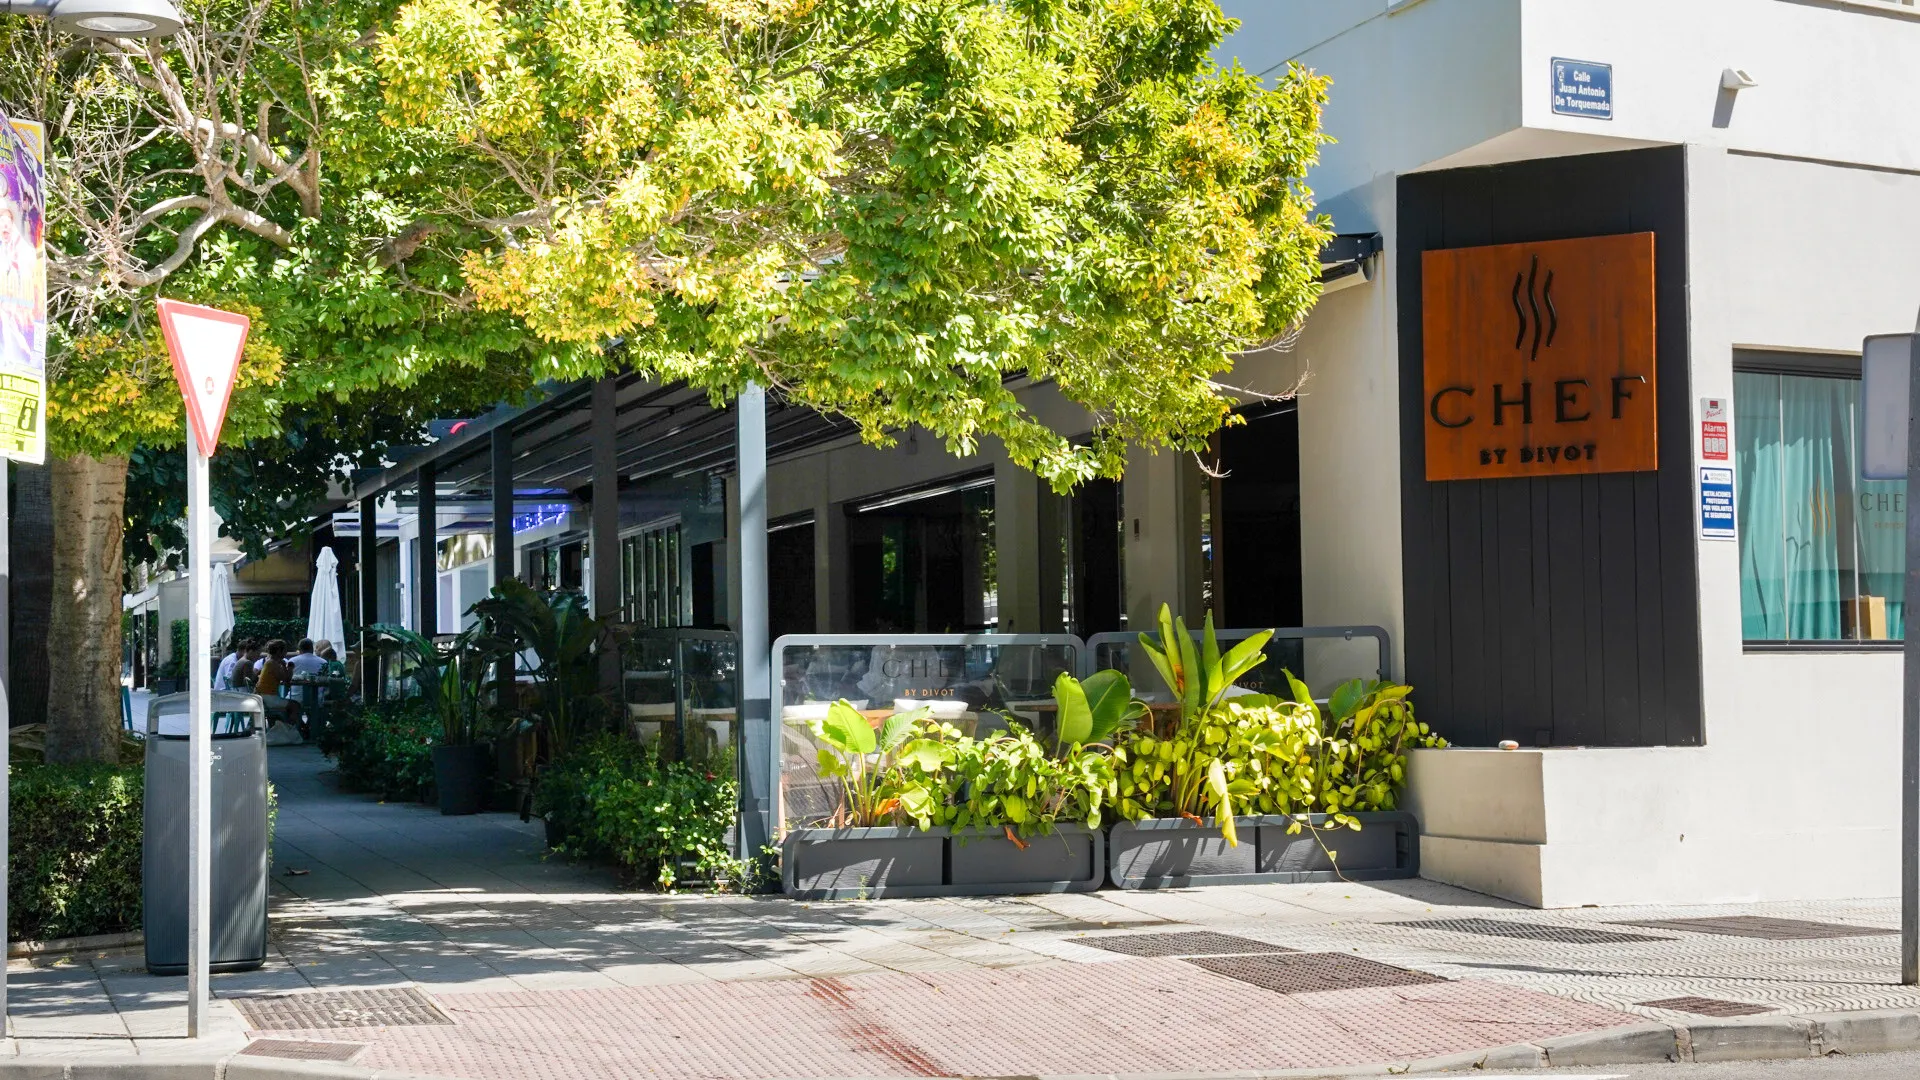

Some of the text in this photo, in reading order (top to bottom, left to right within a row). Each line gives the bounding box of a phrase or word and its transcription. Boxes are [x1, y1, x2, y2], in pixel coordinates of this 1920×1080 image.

[1573, 71, 1591, 82] Calle
[1559, 83, 1606, 97] Juan Antonio
[1555, 95, 1610, 110] De Torquemada
[1430, 375, 1646, 428] CHEF
[1703, 423, 1727, 433] Alarma
[1479, 444, 1597, 465] BY DIVOT
[1860, 492, 1904, 512] CHE
[904, 689, 955, 697] BY DIVOT
